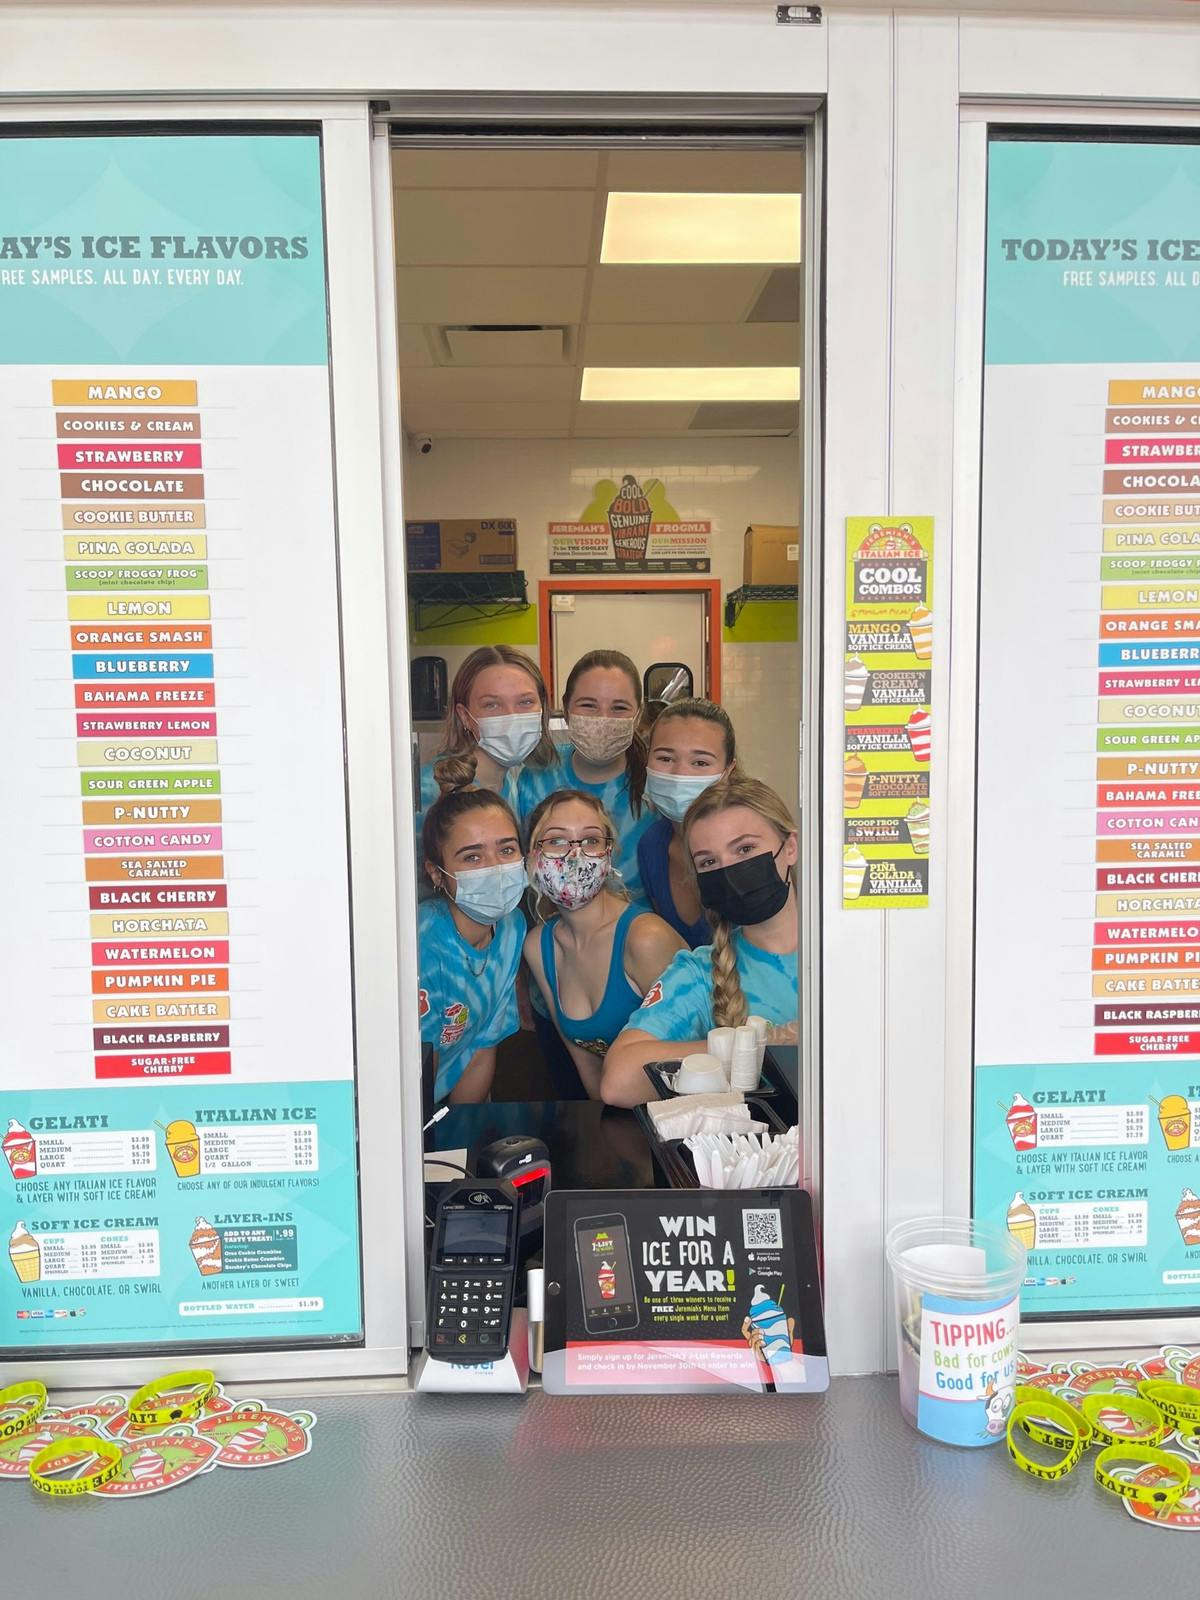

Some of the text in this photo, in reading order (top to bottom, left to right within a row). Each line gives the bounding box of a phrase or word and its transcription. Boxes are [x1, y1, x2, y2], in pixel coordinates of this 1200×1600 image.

[82, 237, 140, 258] ICE
[151, 236, 309, 258] FLAVORS
[1001, 239, 1137, 260] TODAY'S
[32, 269, 98, 285] SAMPLES.
[104, 269, 127, 285] ALL
[133, 269, 162, 285] DAY.
[168, 269, 210, 285] EVERY
[217, 269, 244, 285] DAY.
[1064, 271, 1186, 286] FREE SAMPLES. ALL
[88, 386, 162, 400] MANGO
[64, 420, 193, 431] COOKIES & CREAM
[76, 451, 183, 462] STRAWBERRY
[81, 480, 183, 492] CHOCOLATE
[621, 485, 642, 499] COOL
[614, 499, 648, 513] BOLD
[74, 510, 193, 523] COOKIE BUTTER
[611, 514, 649, 528] GENUINE
[656, 524, 706, 532] FROGMA
[78, 542, 193, 554] PINA COLADA
[861, 550, 901, 558] ITALIAN
[75, 570, 114, 579] SCOOP
[118, 570, 163, 579] FROGGY
[860, 568, 921, 583] COOL
[859, 584, 921, 594] COMBOS
[1138, 590, 1198, 603] LEMON
[108, 602, 171, 615] LEMON
[848, 624, 901, 633] MANGO
[1106, 621, 1169, 631] ORANGE
[76, 631, 203, 643] ORANGE SMASH
[848, 634, 912, 644] VANILLA
[96, 660, 190, 673] BLUEBERRY
[873, 680, 918, 688] CREAM
[84, 691, 149, 702] BAHAMA
[872, 689, 925, 697] VANILLA
[83, 720, 210, 731] STRAWBERRY LEMON
[858, 735, 908, 743] VANILLA
[104, 747, 192, 761] COCONUT
[1128, 762, 1198, 775] P-NUTTY
[89, 778, 212, 789] SOUR GREEN APPLE
[869, 775, 920, 783] P-NUTTY
[114, 807, 190, 819] P-NUTTY
[856, 827, 899, 836] SWIRL
[94, 834, 212, 847] COTTON CANDY
[121, 860, 187, 869] SEA SALTED
[870, 862, 896, 871] PIÑA
[129, 869, 180, 878] CARAMEL
[870, 880, 923, 888] VANILLA
[100, 891, 216, 903] BLACK CHERRY
[113, 918, 207, 932] HORCHATA
[105, 947, 215, 959] WATERMELON
[105, 973, 216, 987] PUMPKIN PIE
[106, 1003, 217, 1017] CAKE BATTER
[103, 1032, 220, 1044] BLACK RASPBERRY
[1139, 1043, 1178, 1051] CHERRY
[131, 1057, 195, 1065] SUGAR-FREE
[144, 1065, 183, 1074] CHERRY
[195, 1108, 316, 1122] ITALIAN ICE
[29, 1115, 108, 1130] GELATI
[15, 1178, 156, 1192] CHOOSE ANY ITALIAN ICE FLAVOR
[178, 1181, 204, 1191] CHOOSE
[207, 1180, 220, 1190] ANY
[223, 1180, 231, 1189] OF
[234, 1179, 247, 1189] OUR
[250, 1179, 285, 1188] INDULGENT
[17, 1194, 23, 1203] &
[28, 1192, 53, 1203] LAYER
[57, 1191, 80, 1202] WITH
[84, 1191, 104, 1201] SOFT
[108, 1190, 121, 1200] ICE
[32, 1217, 159, 1230] SOFT ICE CREAM
[214, 1212, 293, 1224] LAYER-INS
[659, 1216, 716, 1237] WIN
[643, 1241, 735, 1266] ICE FOR A
[202, 1278, 299, 1290] ANOTHER LAYER OF SWEET
[644, 1269, 736, 1292] YEAR!
[119, 1285, 130, 1294] OR
[134, 1283, 162, 1294] SWIRL
[934, 1350, 960, 1369] Bad
[967, 1354, 986, 1368] for
[936, 1372, 973, 1390] Good
[217, 1413, 301, 1444] JEREMIAH'S
[107, 1465, 192, 1490] ITALIAN ICE
